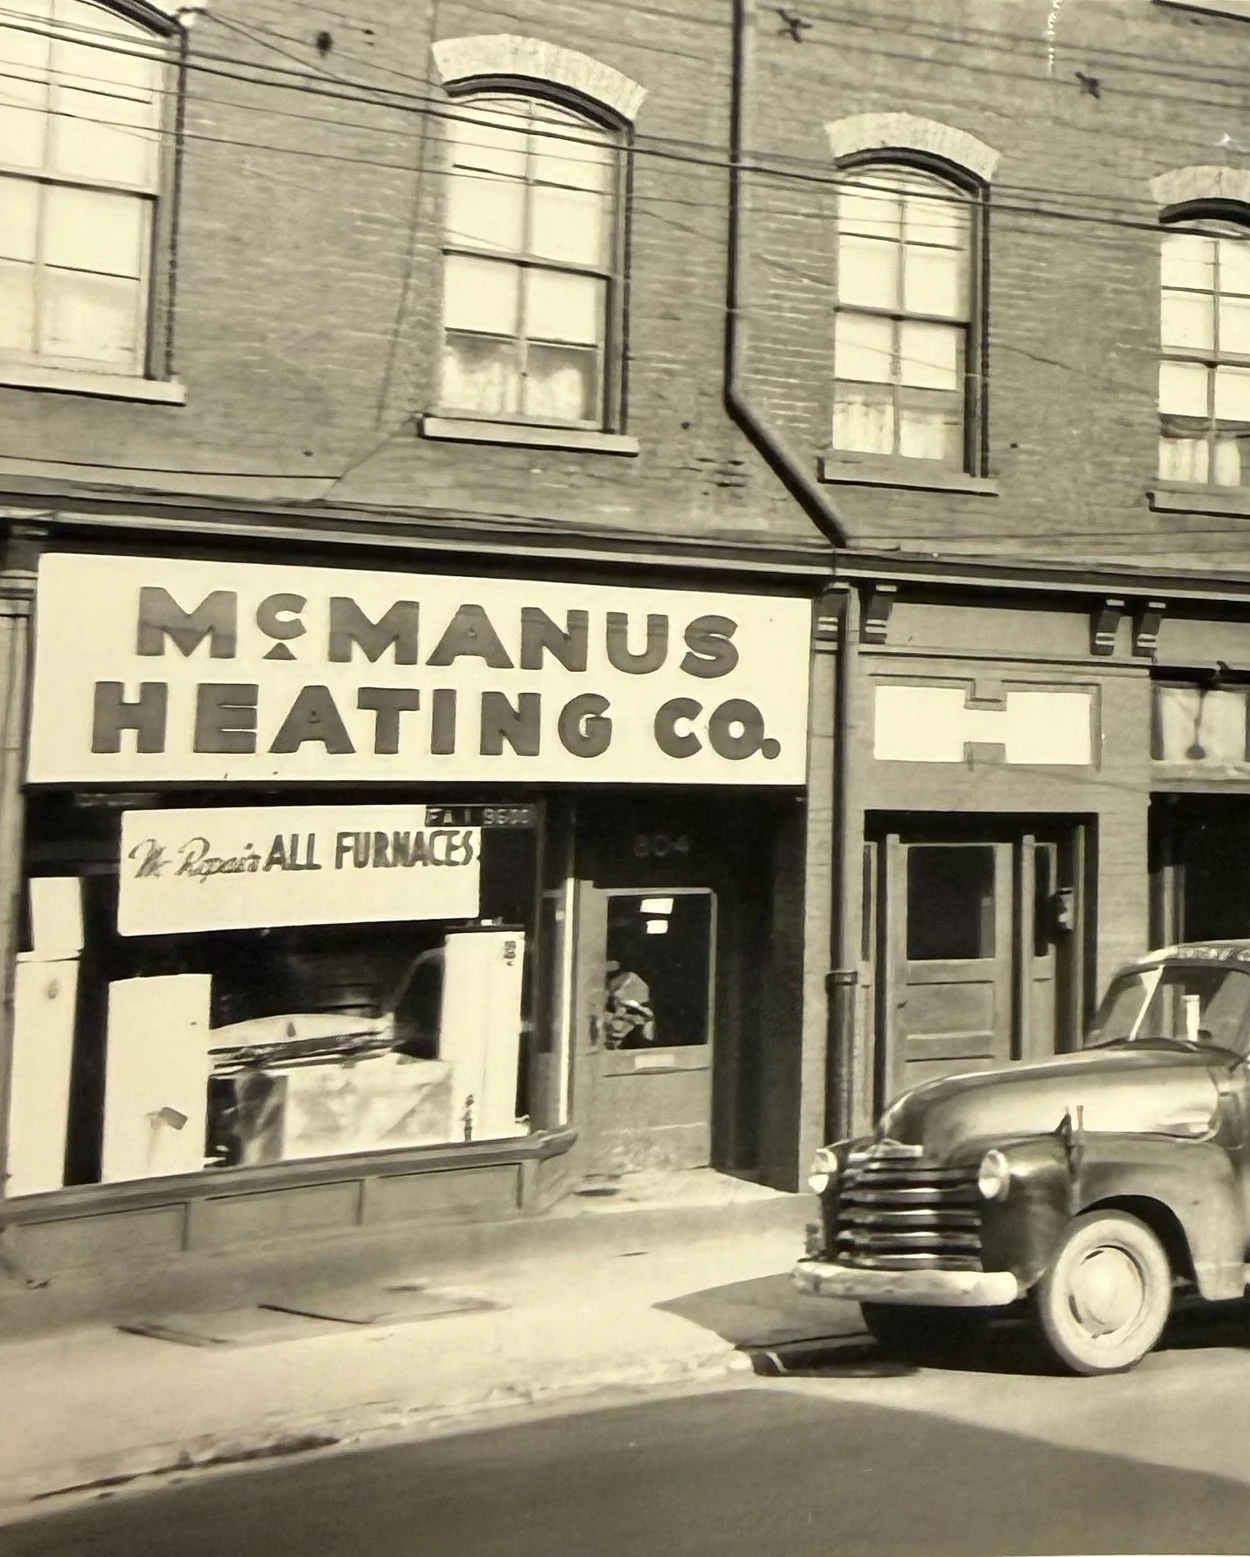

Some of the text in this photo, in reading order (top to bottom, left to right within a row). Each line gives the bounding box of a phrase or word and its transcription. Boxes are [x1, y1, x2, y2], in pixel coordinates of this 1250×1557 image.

[91, 681, 781, 760] HEATING CO.
[263, 832, 322, 871] ALL
[334, 829, 474, 869] FURNACES
